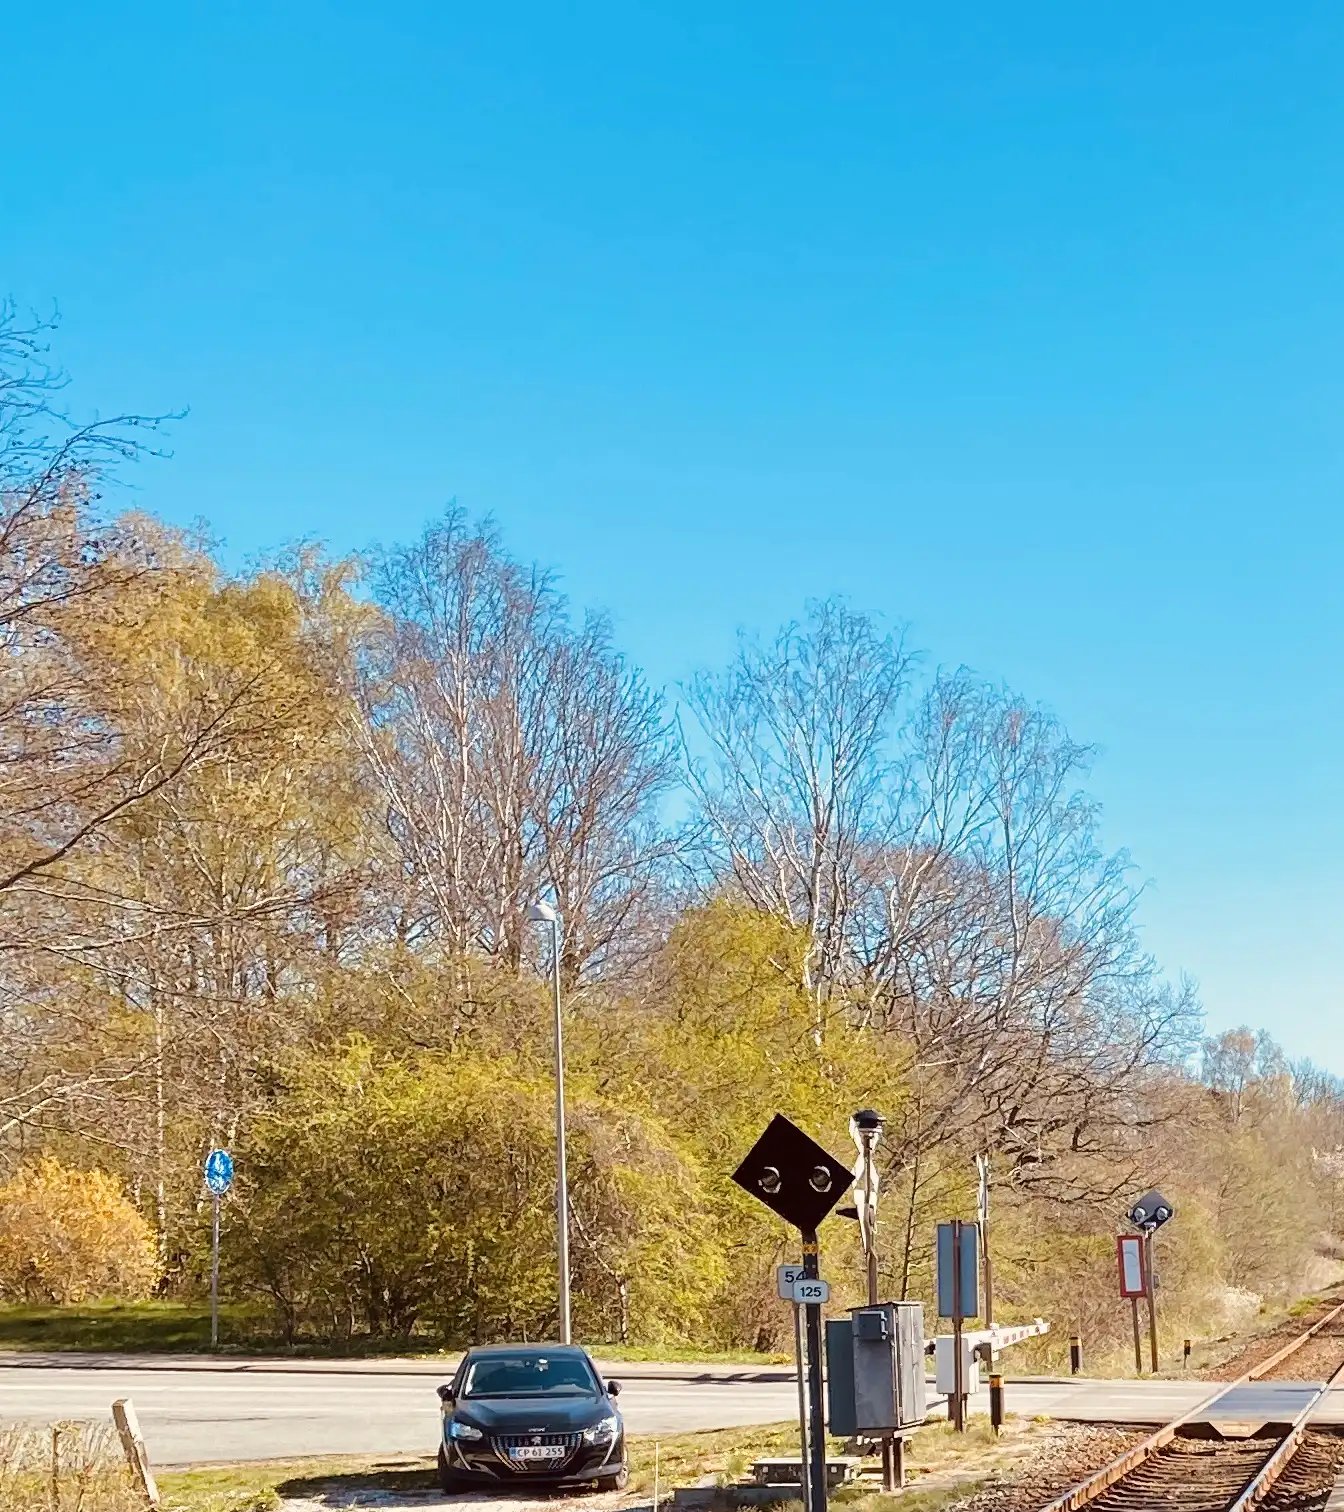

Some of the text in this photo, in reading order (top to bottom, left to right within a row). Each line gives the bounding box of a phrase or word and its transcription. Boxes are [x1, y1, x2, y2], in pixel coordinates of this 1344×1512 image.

[800, 1286, 822, 1298] 125
[517, 1449, 530, 1457] CP
[545, 1448, 563, 1456] 255
